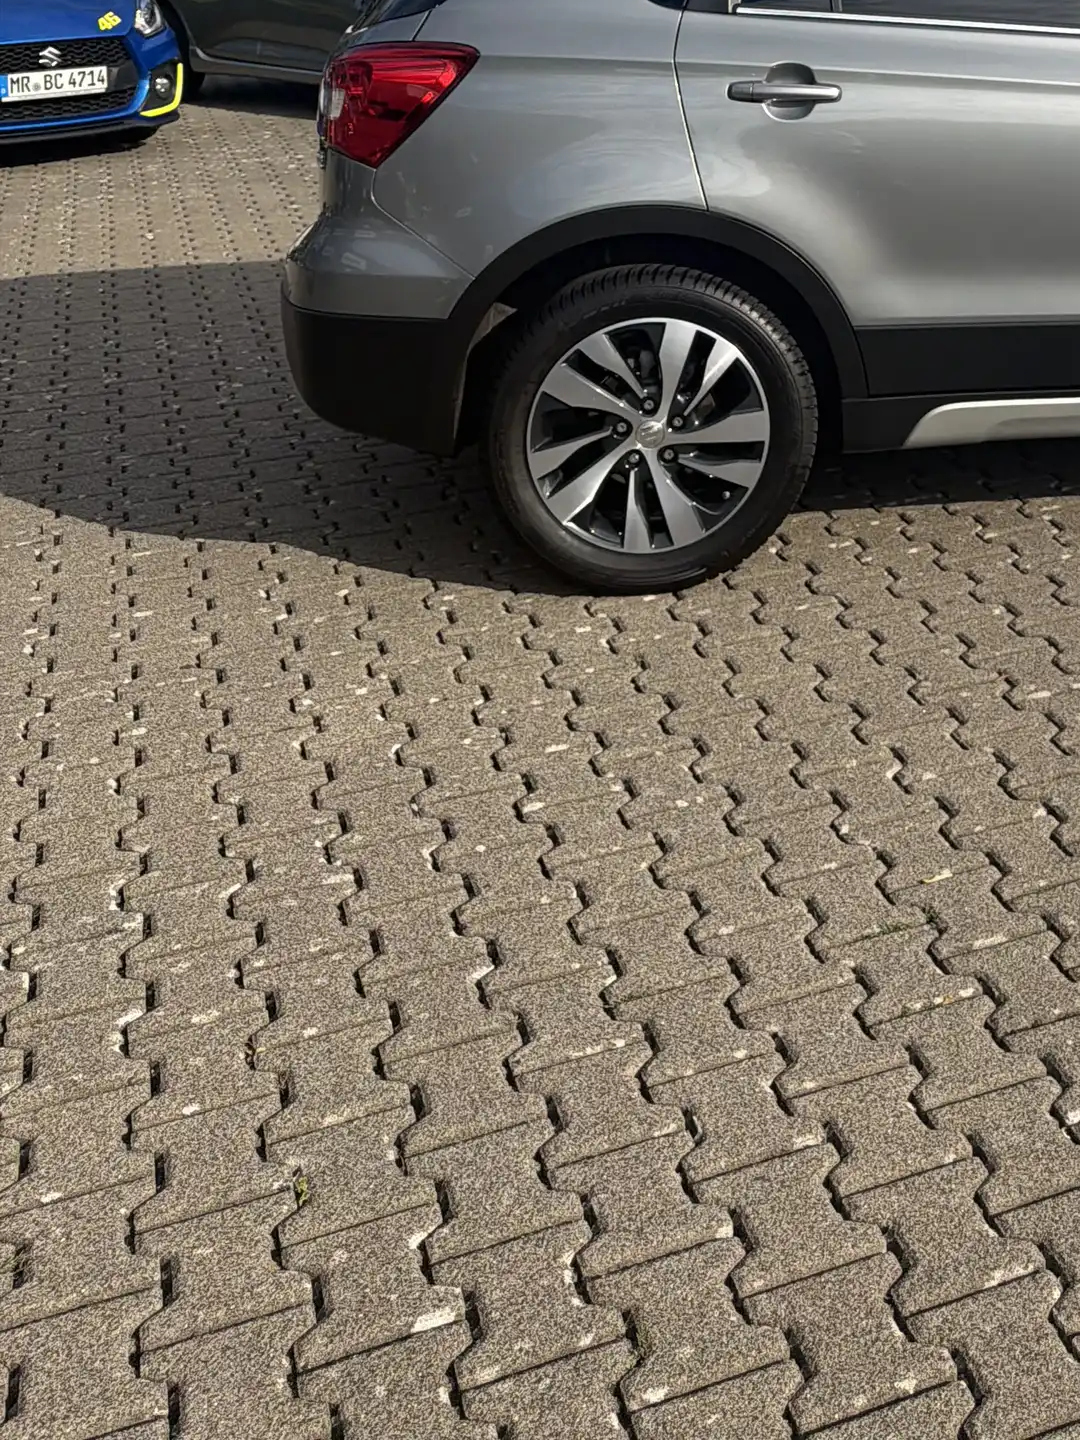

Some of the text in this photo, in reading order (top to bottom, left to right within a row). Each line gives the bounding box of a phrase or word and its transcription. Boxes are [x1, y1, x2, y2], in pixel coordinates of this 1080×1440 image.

[97, 11, 122, 31] 46
[10, 76, 31, 94] MR
[43, 73, 64, 91] BC
[68, 69, 105, 88] 4714
